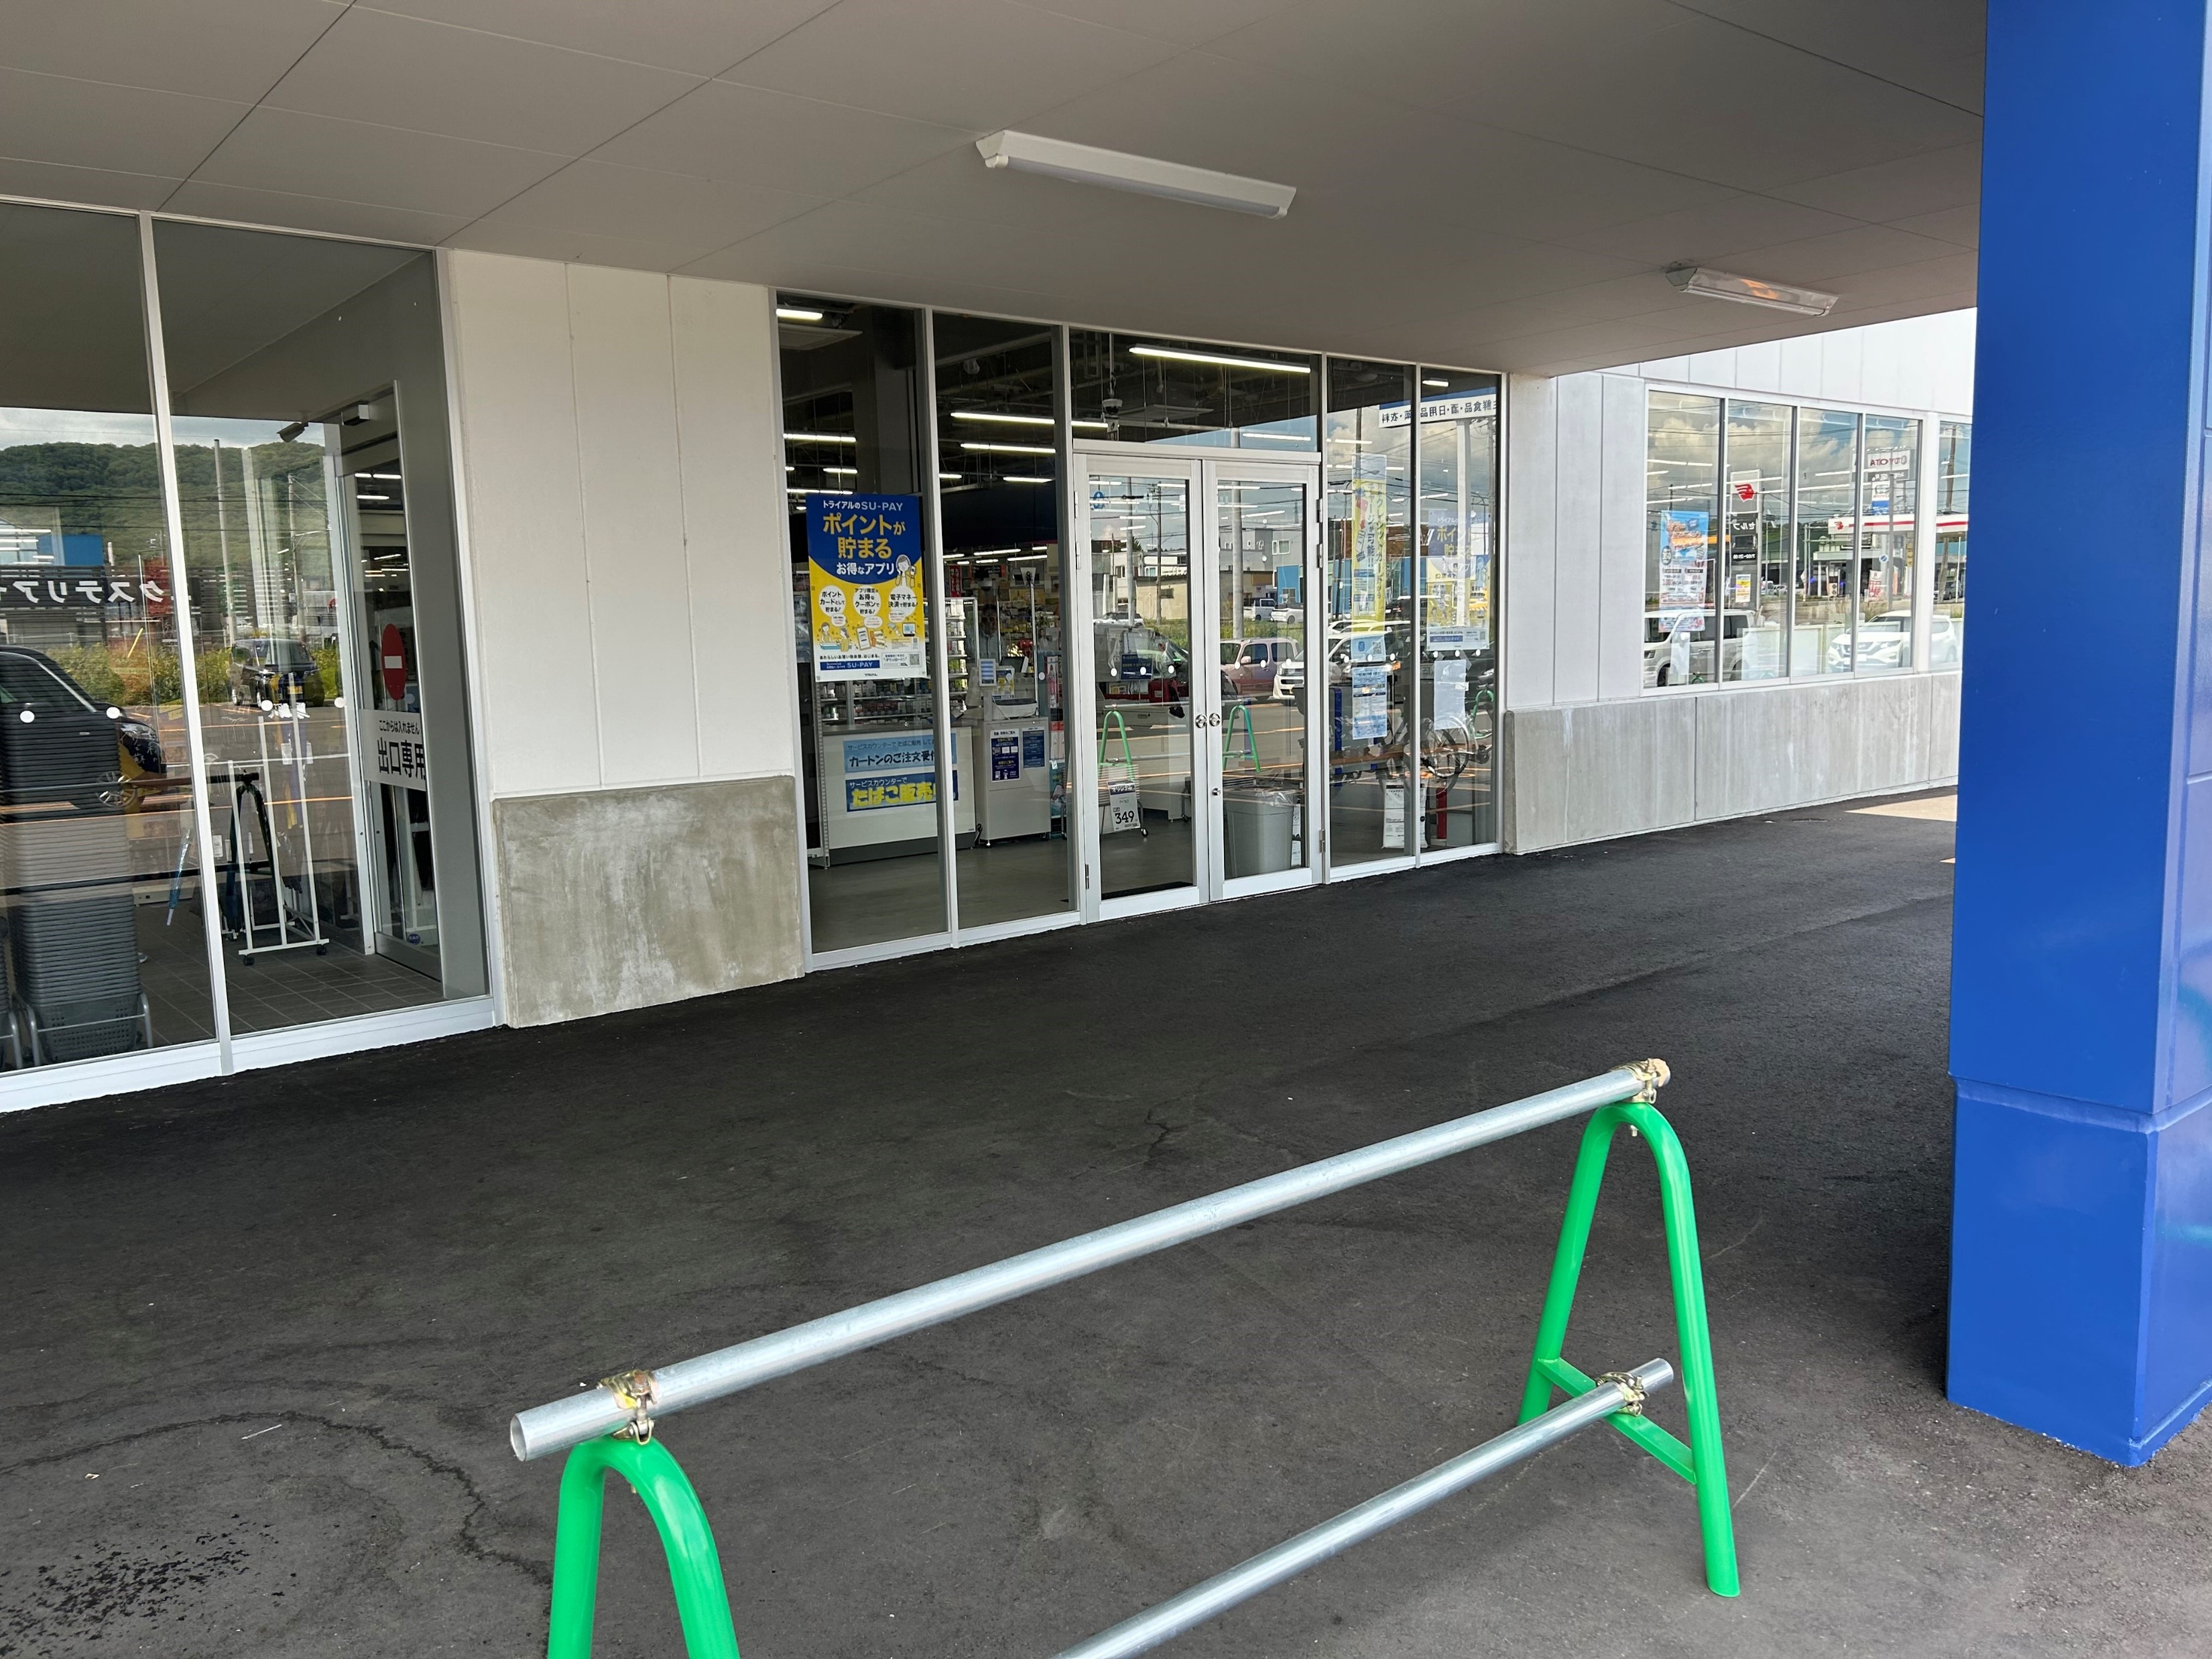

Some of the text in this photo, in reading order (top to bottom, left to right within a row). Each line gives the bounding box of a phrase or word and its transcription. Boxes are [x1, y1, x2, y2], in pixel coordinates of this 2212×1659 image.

[823, 513, 906, 536] ポイントが
[837, 537, 892, 559] 貯まる
[836, 562, 895, 576] お得なアプリ
[379, 719, 420, 735] ここからは入れません
[847, 741, 898, 751] サービスカウンターで
[898, 739, 922, 747] たばこ販売
[377, 737, 426, 781] 出口専用
[849, 777, 908, 788] サービスカウンターで
[852, 782, 936, 808] たばこ販売
[1115, 810, 1134, 824] 349
